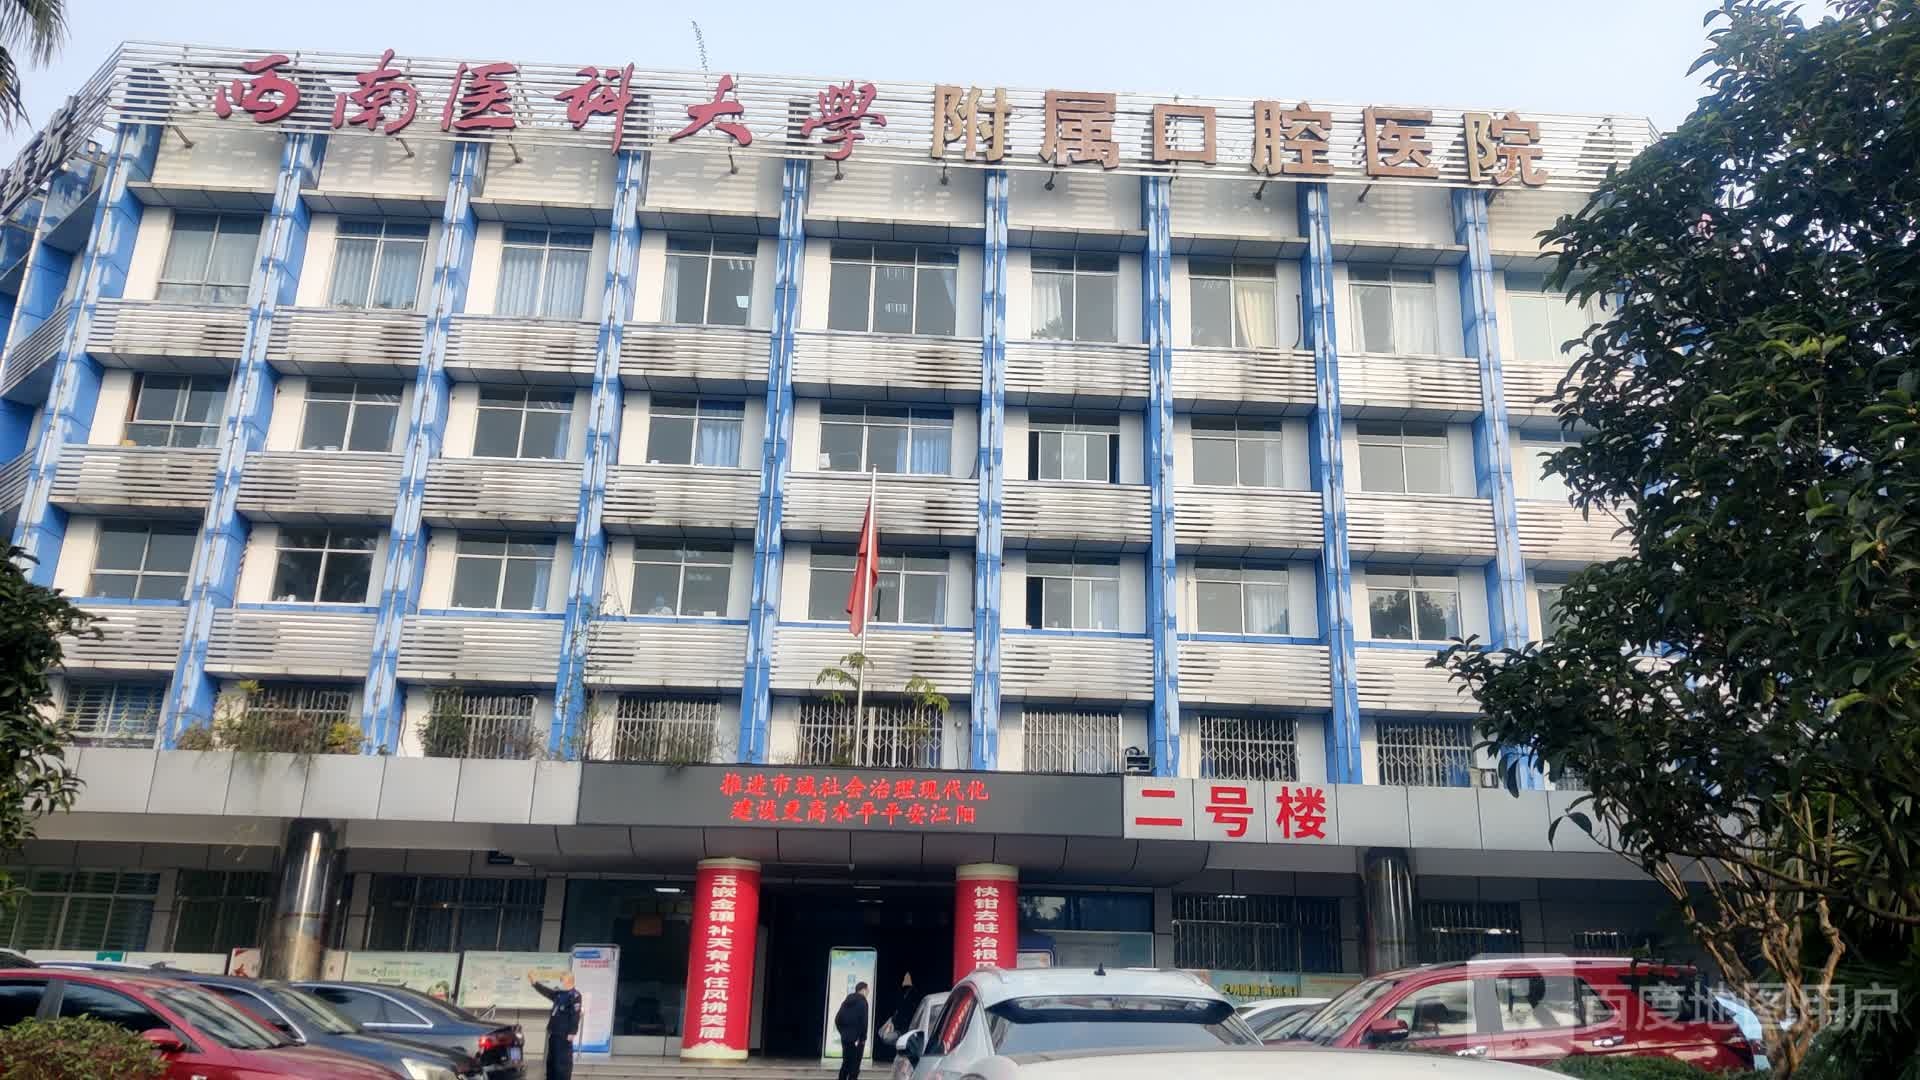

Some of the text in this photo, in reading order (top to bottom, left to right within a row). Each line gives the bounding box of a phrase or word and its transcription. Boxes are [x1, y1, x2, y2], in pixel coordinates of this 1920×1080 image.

[932, 84, 1547, 187] 附属口腔医院
[720, 773, 989, 801] 推进市域社会治理现代化
[729, 798, 977, 825] 建设更高水平平安江阳
[1135, 786, 1326, 839] 二号楼
